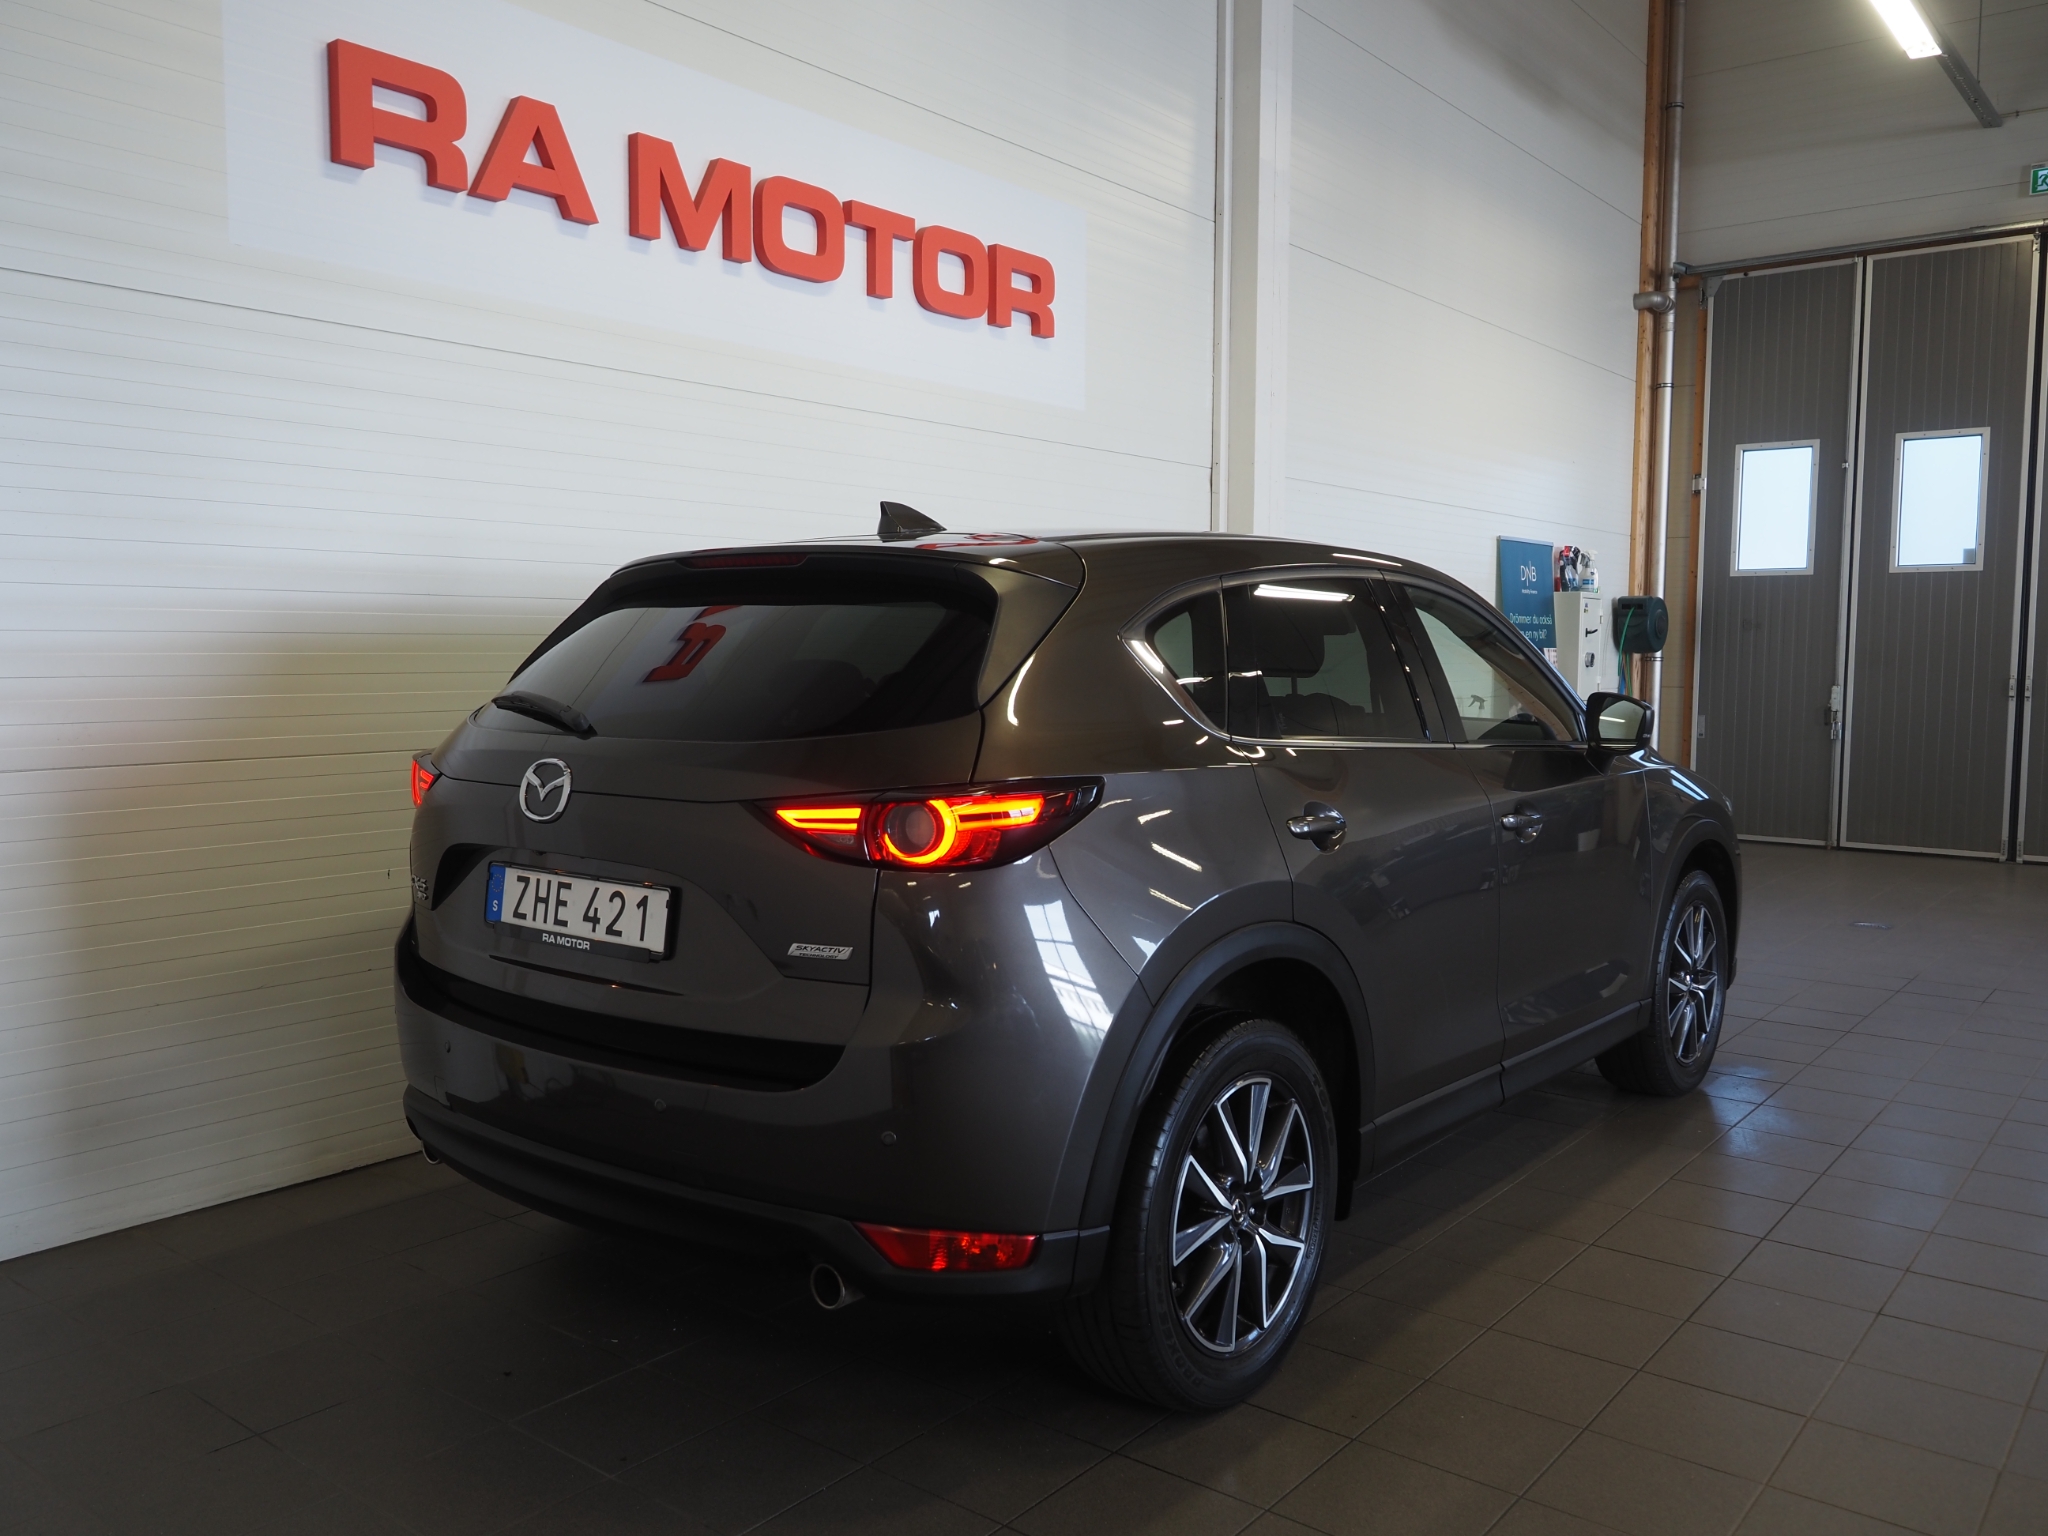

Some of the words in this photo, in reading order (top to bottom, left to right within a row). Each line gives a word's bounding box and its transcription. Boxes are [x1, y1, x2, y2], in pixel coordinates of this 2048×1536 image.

[327, 39, 599, 226] RA
[629, 132, 1056, 339] MOTOR
[1520, 561, 1537, 586] DNB
[1509, 612, 1531, 624] Drömmer
[1532, 613, 1539, 624] du
[1539, 613, 1553, 625] också
[1525, 630, 1532, 639] en
[1532, 630, 1539, 642] ny
[1538, 628, 1547, 639] bil?
[492, 900, 498, 911] S
[512, 875, 572, 928] ZHE
[583, 887, 649, 942] 421
[542, 933, 556, 946] RA
[557, 936, 590, 951] MOTOR
[795, 945, 846, 954] SKYACTIV
